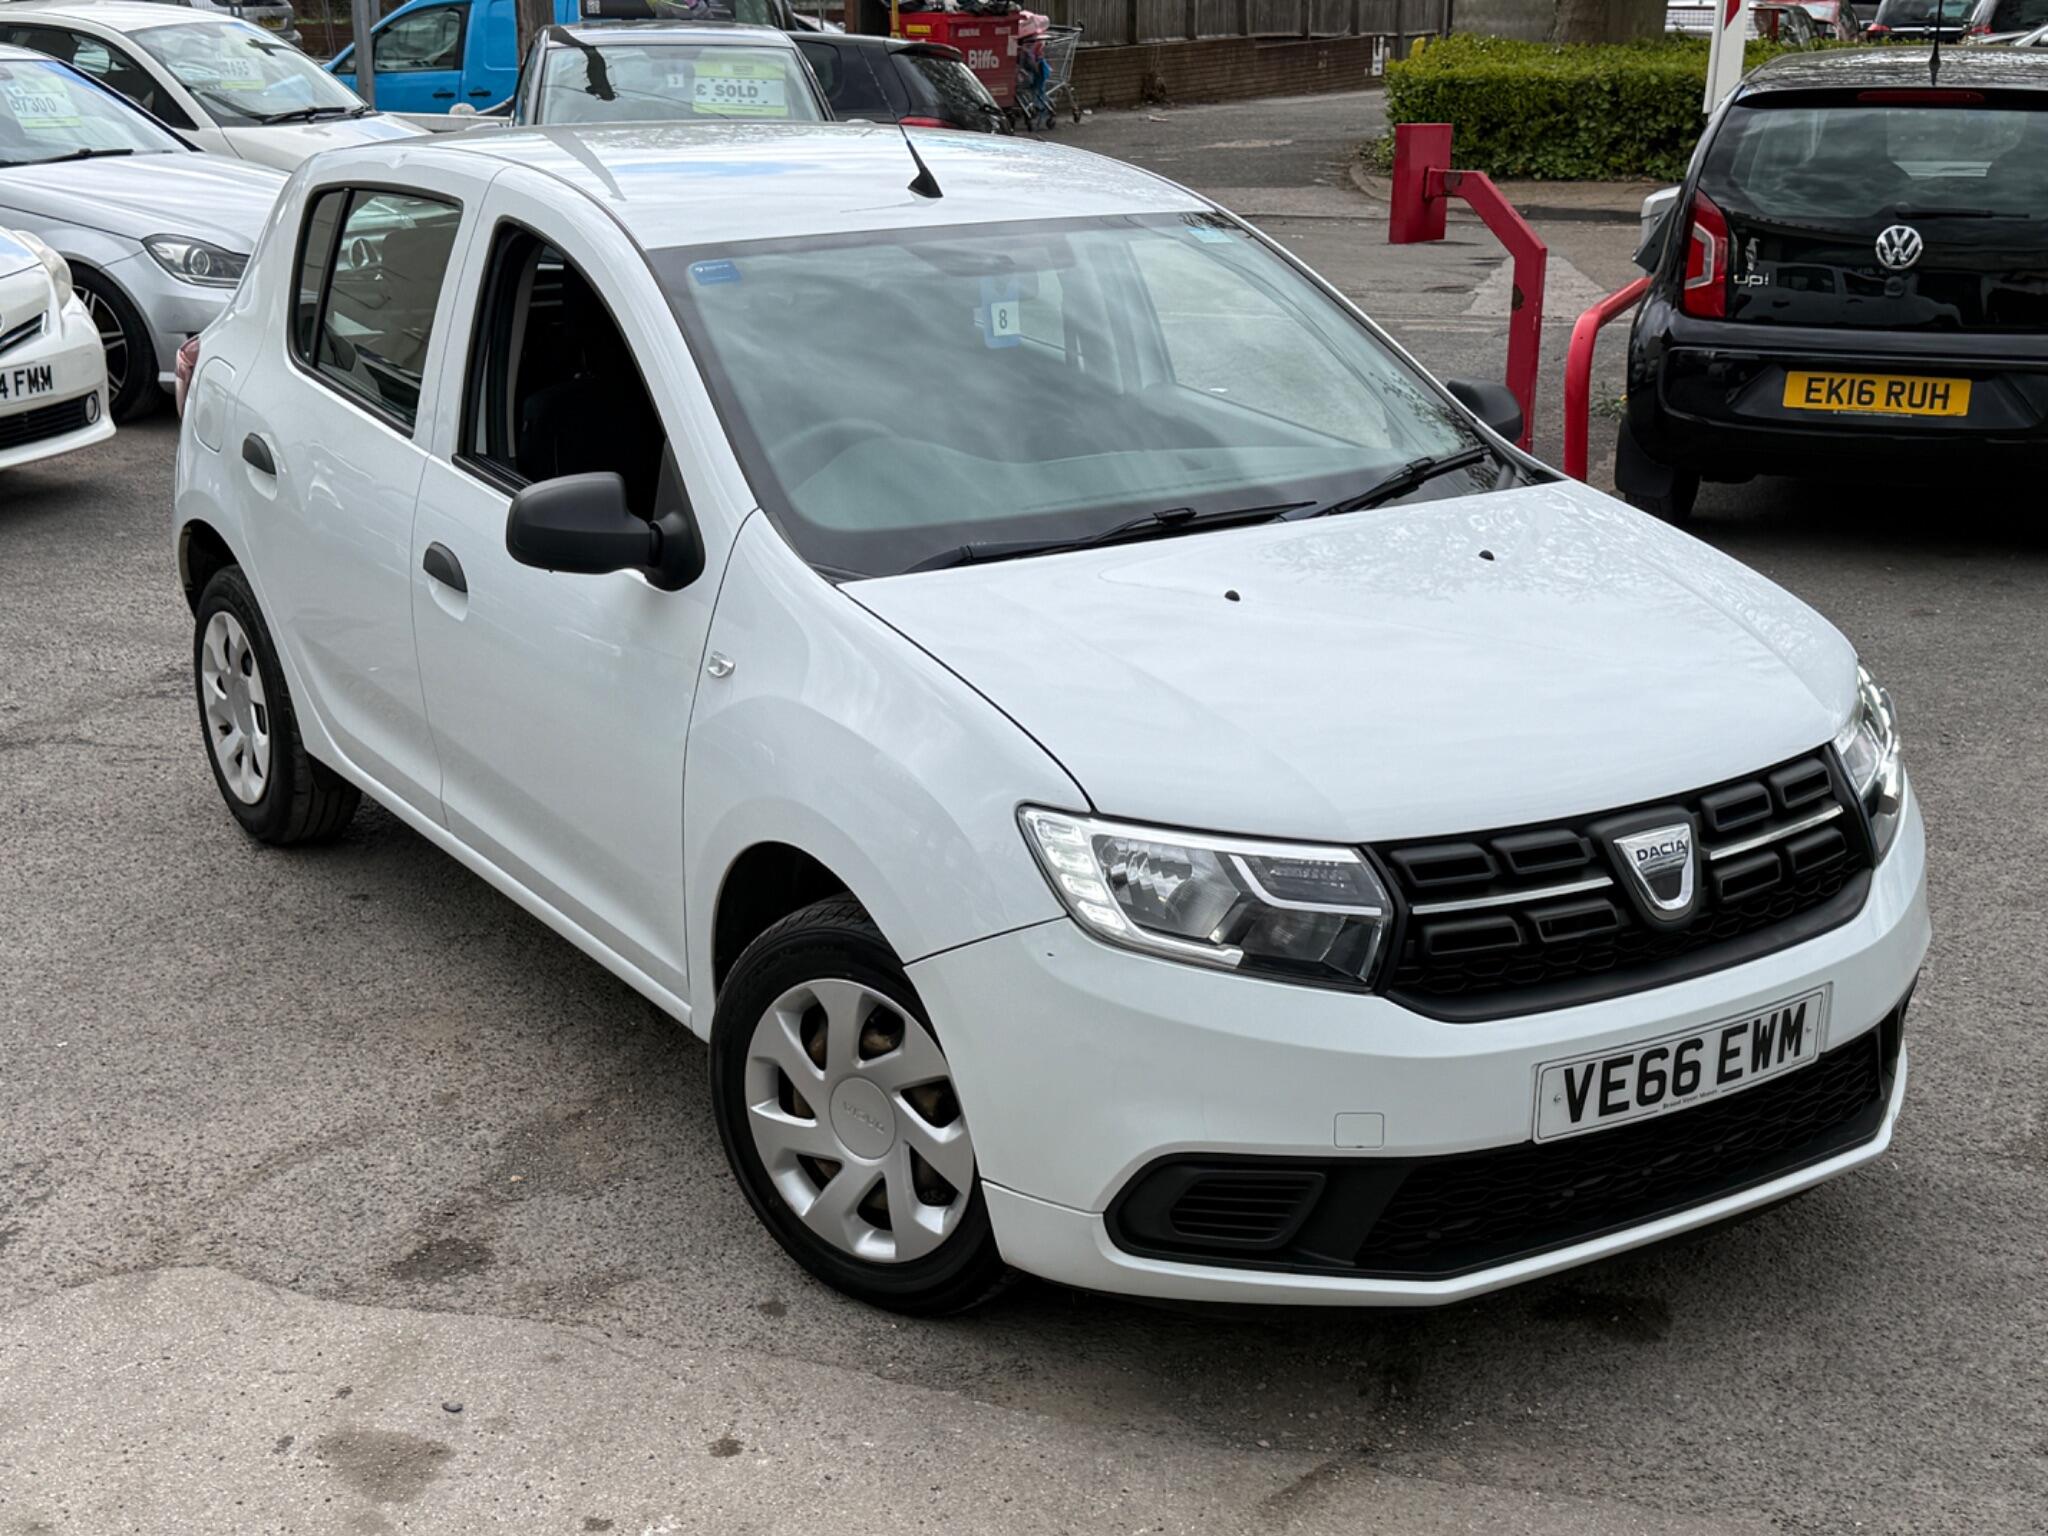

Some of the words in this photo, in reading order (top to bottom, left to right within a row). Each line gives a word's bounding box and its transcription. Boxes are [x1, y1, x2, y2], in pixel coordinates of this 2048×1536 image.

[968, 49, 999, 69] Biffa
[696, 84, 706, 96] £
[714, 84, 758, 98] SOLD
[999, 308, 1008, 329] 8
[14, 365, 53, 397] FMM
[1805, 376, 1876, 406] EK16
[1885, 380, 1950, 410] RUH
[1636, 839, 1686, 861] DACIA
[1564, 1037, 1704, 1123] VE66
[1716, 1002, 1806, 1085] EWM
